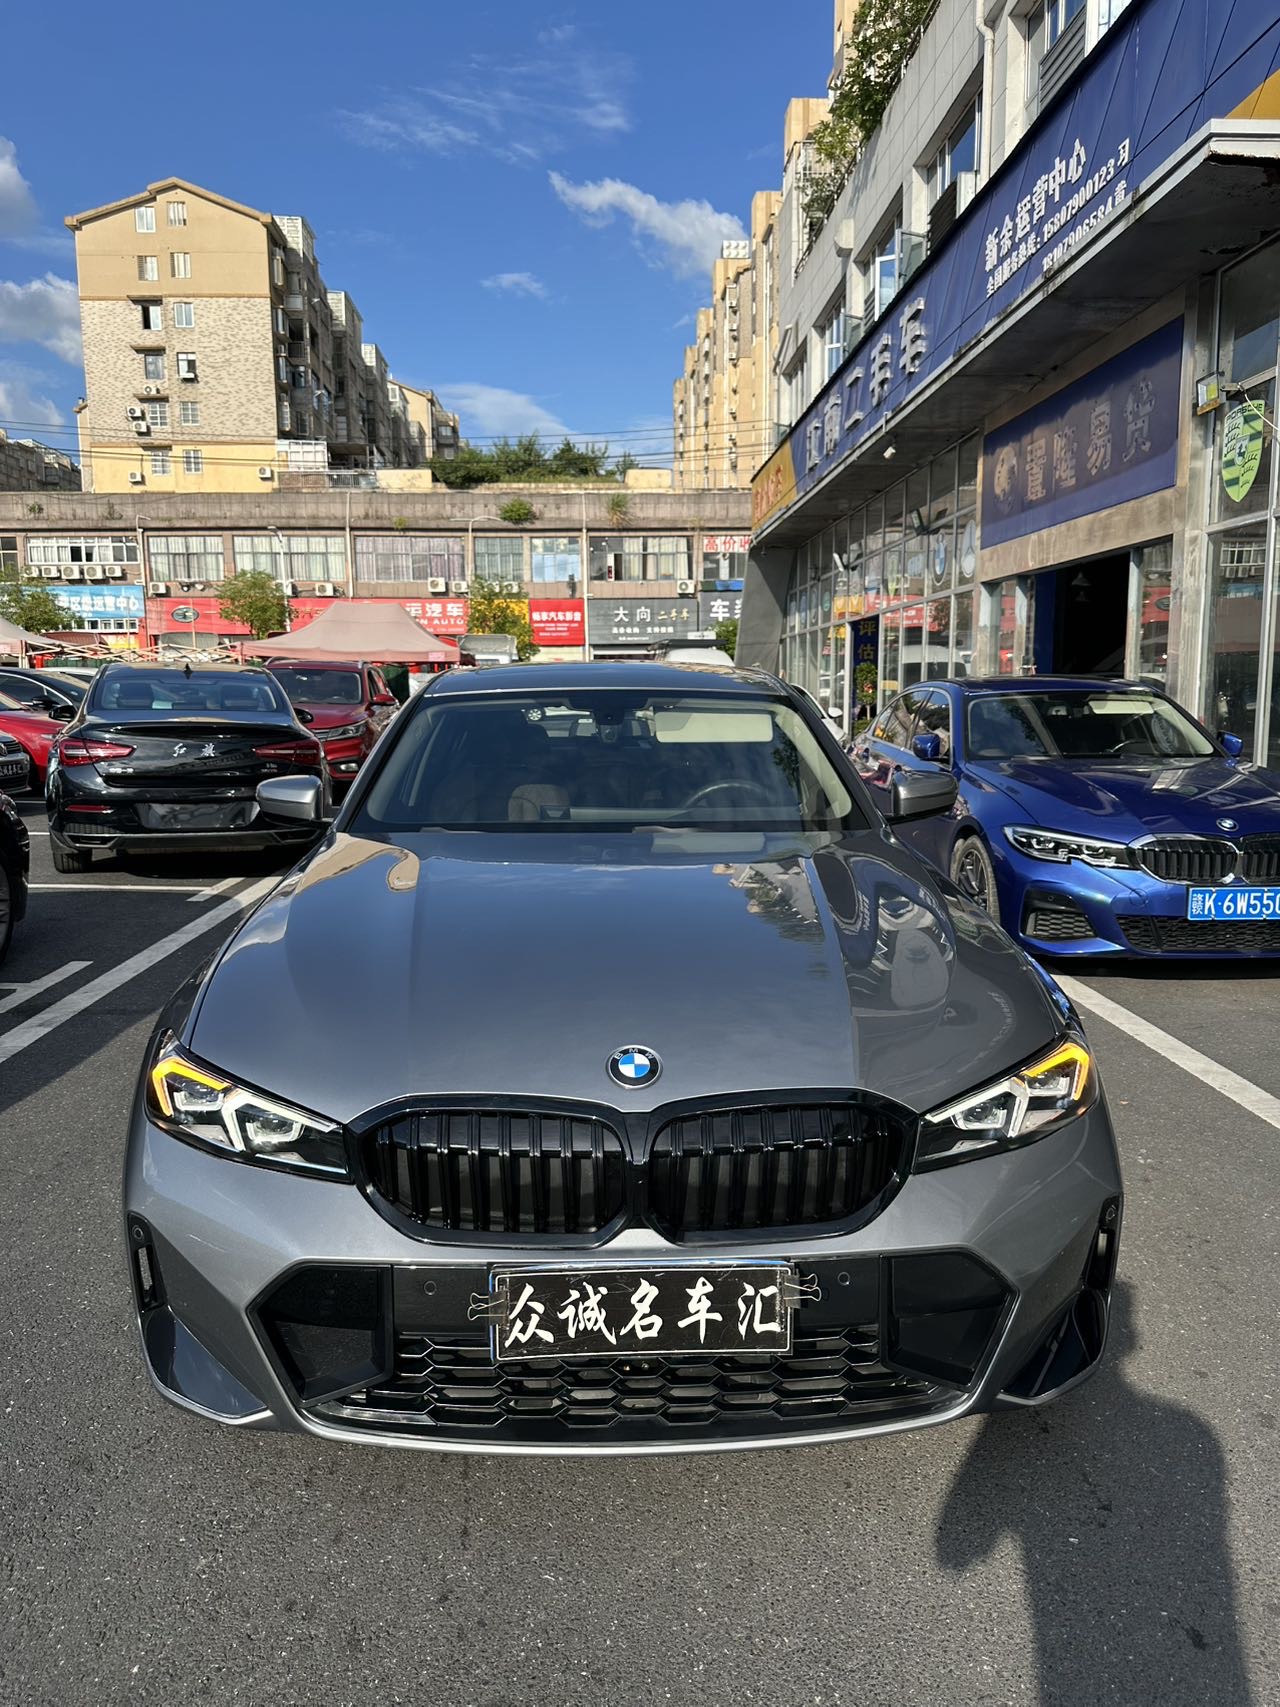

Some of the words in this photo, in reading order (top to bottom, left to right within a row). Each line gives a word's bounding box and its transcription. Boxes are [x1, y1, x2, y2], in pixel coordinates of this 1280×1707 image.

[984, 138, 1087, 271] 新余运营中心
[1226, 402, 1264, 423] PORSCHE
[614, 606, 651, 622] 大向
[657, 608, 690, 621] 二手车
[857, 620, 877, 661] 评估
[613, 1048, 655, 1060] BMW
[504, 1276, 780, 1349] 众诚名车汇
